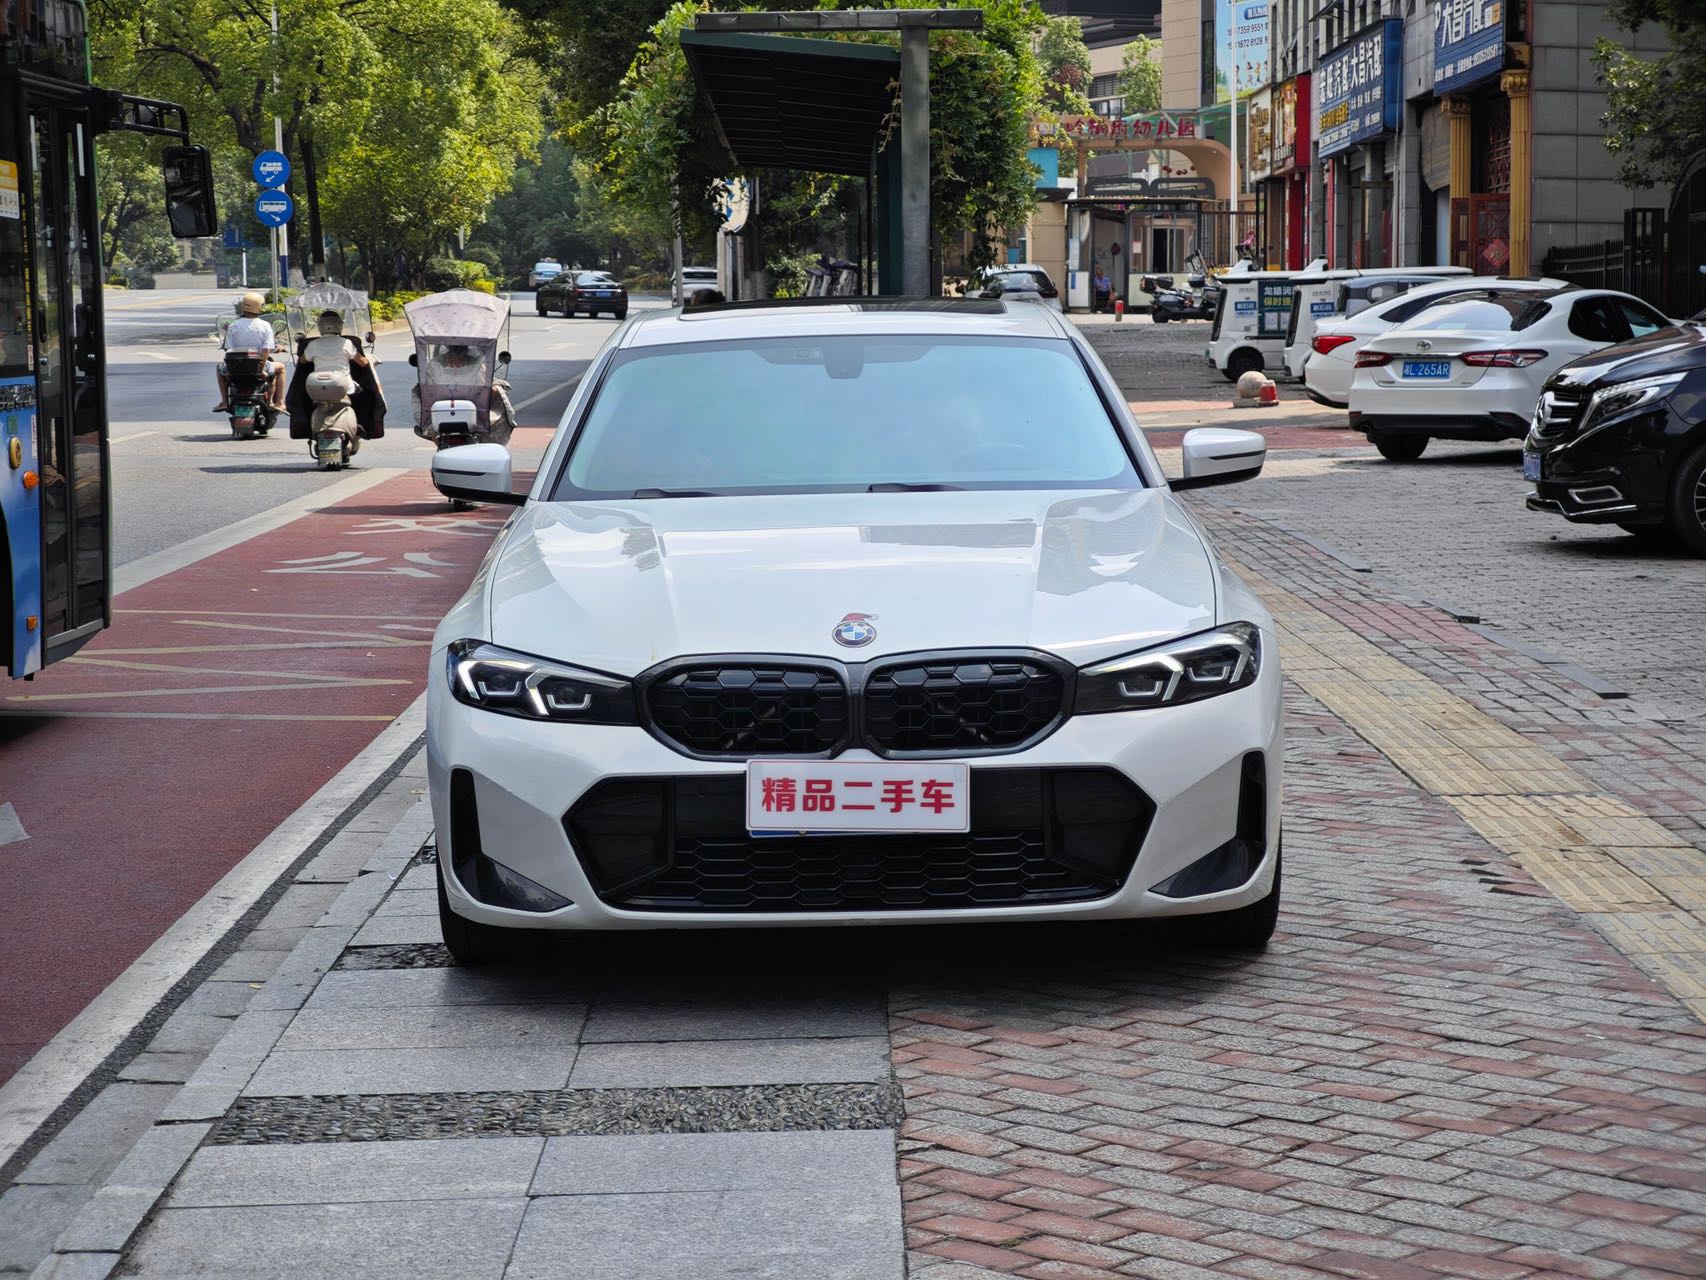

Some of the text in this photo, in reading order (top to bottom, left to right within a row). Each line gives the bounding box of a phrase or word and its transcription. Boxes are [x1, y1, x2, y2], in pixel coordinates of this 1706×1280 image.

[761, 777, 955, 814] 精品二手车
